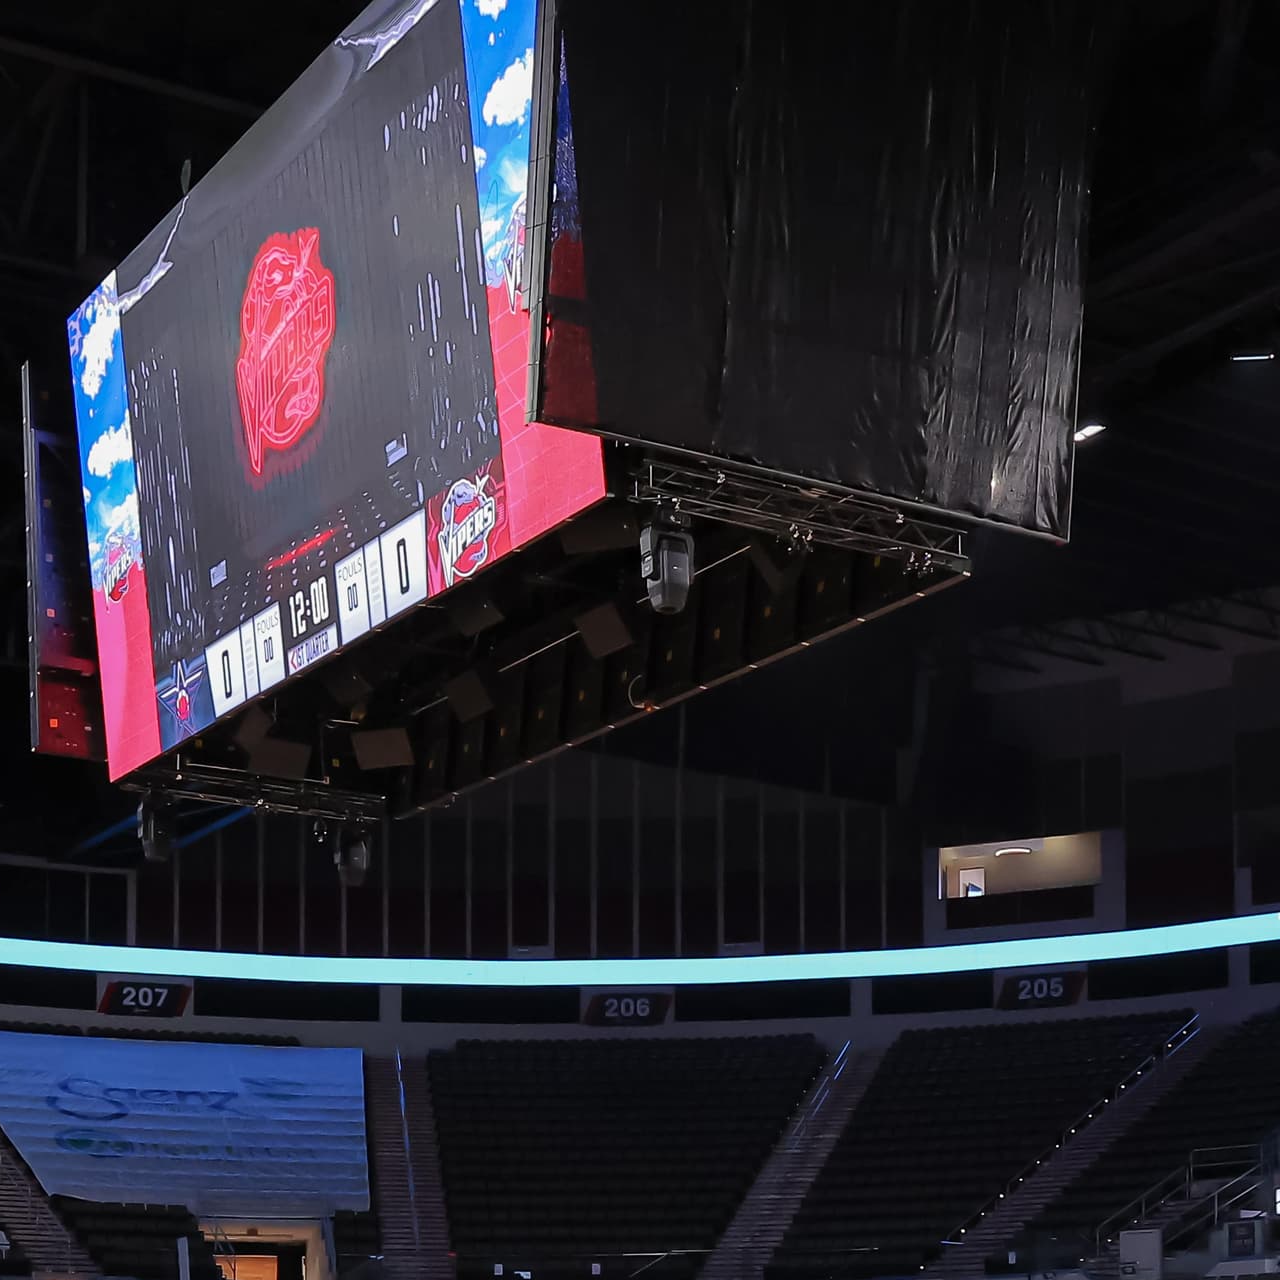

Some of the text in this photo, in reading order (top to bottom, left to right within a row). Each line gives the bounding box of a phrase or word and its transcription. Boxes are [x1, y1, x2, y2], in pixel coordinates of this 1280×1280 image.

[438, 499, 495, 587] VIPERS
[338, 558, 363, 582] FOULS
[397, 537, 410, 595] 0
[288, 576, 330, 639] 12:00
[347, 586, 360, 612] 00
[256, 613, 280, 635] FOULS
[264, 638, 274, 664] 00
[306, 631, 330, 664] QUARTER
[221, 649, 233, 700] 0
[122, 985, 169, 1009] 207
[1018, 976, 1063, 1001] 205
[604, 996, 650, 1019] 206
